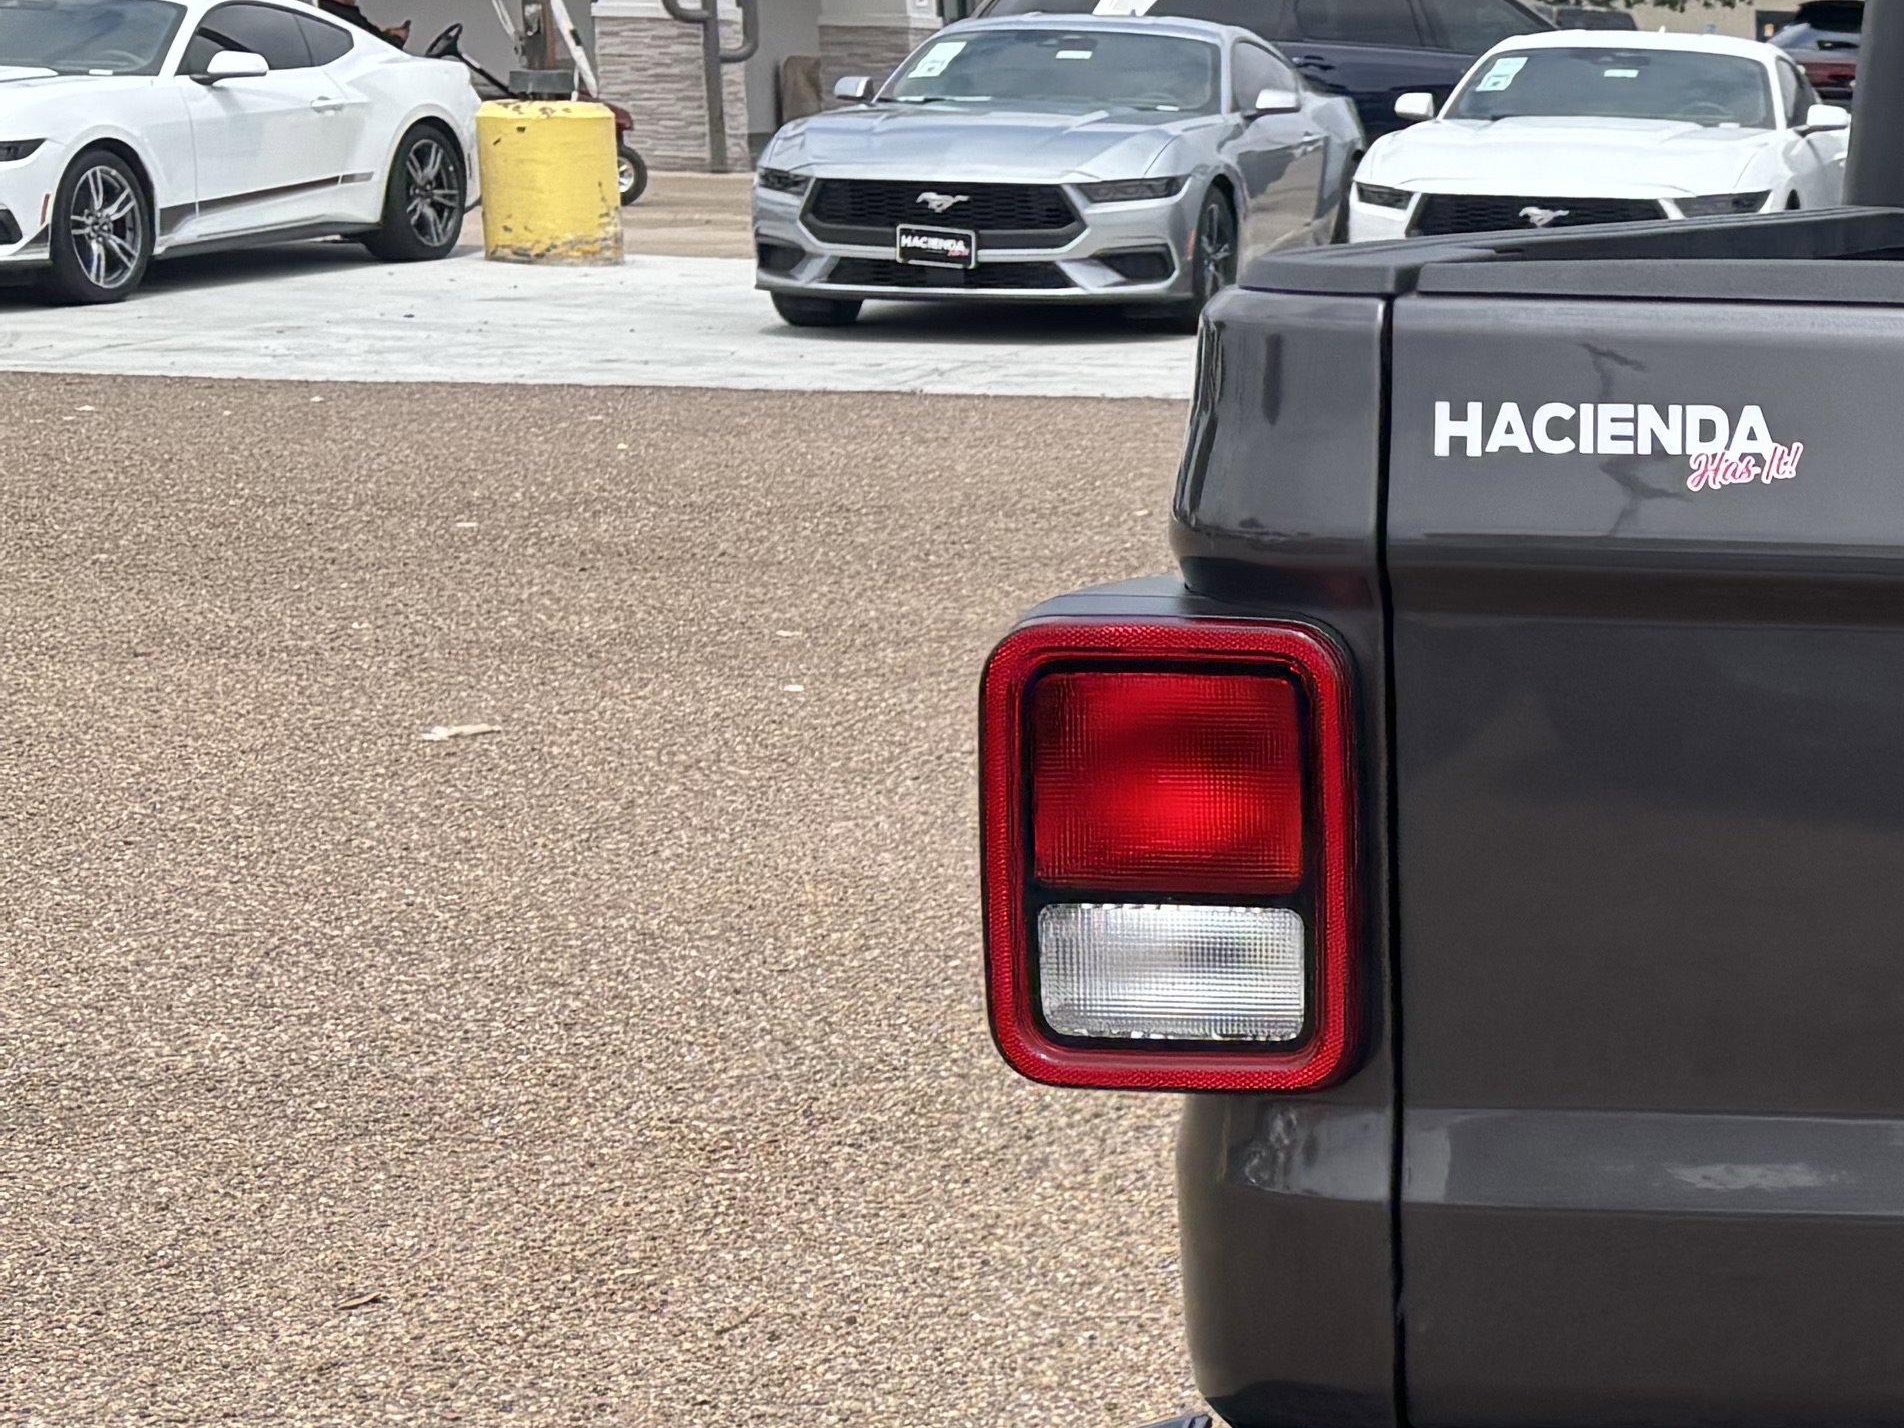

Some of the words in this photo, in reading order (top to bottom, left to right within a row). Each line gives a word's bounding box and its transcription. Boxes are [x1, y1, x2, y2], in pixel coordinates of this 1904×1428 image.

[1434, 401, 1776, 457] HACIENDA
[1687, 451, 1762, 491] Has
[1761, 442, 1804, 484] It!
